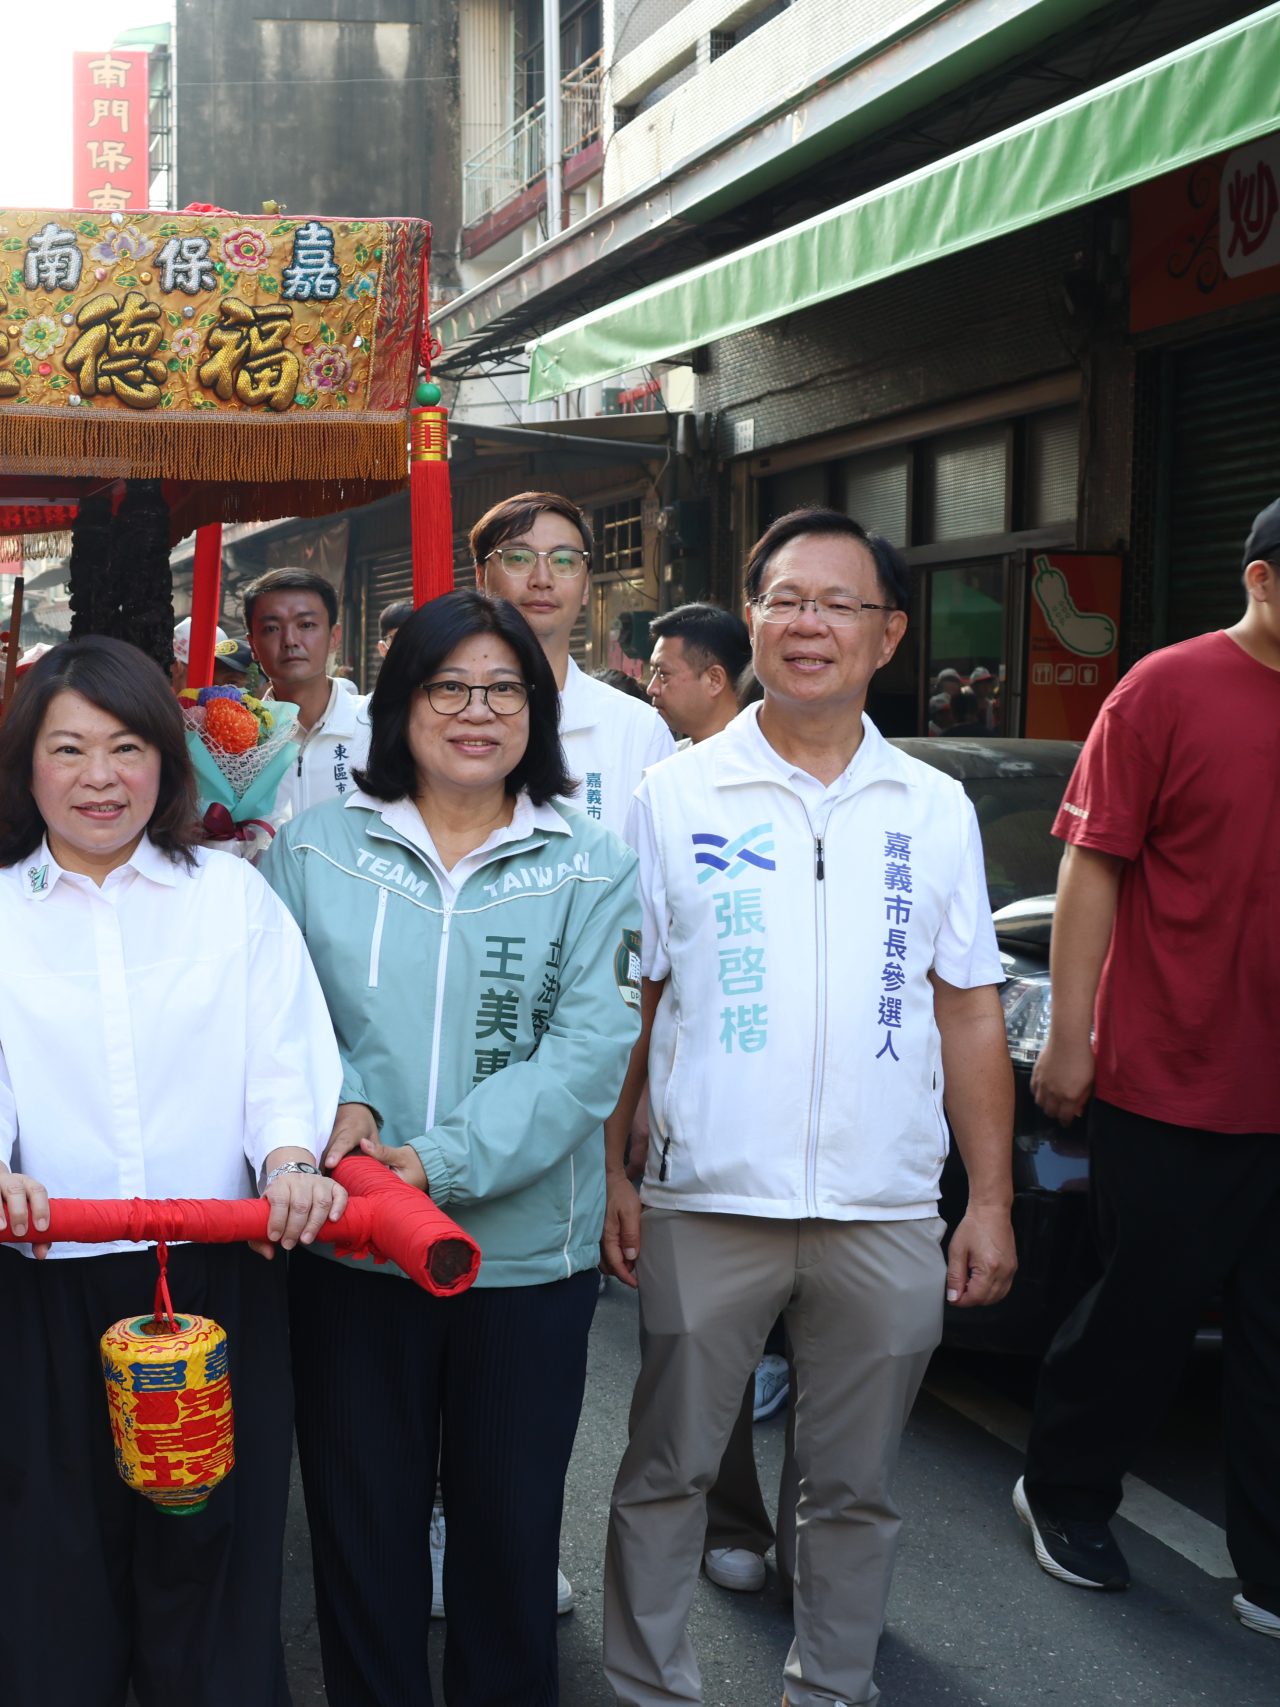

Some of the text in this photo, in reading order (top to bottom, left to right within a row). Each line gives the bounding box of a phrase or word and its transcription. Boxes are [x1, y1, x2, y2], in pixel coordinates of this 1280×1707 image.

[86, 53, 133, 209] 南門保南
[333, 743, 349, 795] 東區市
[586, 772, 602, 820] 嘉義市
[355, 848, 590, 898] TEAM TAIWAN
[875, 830, 913, 1062] 嘉義市長參選人
